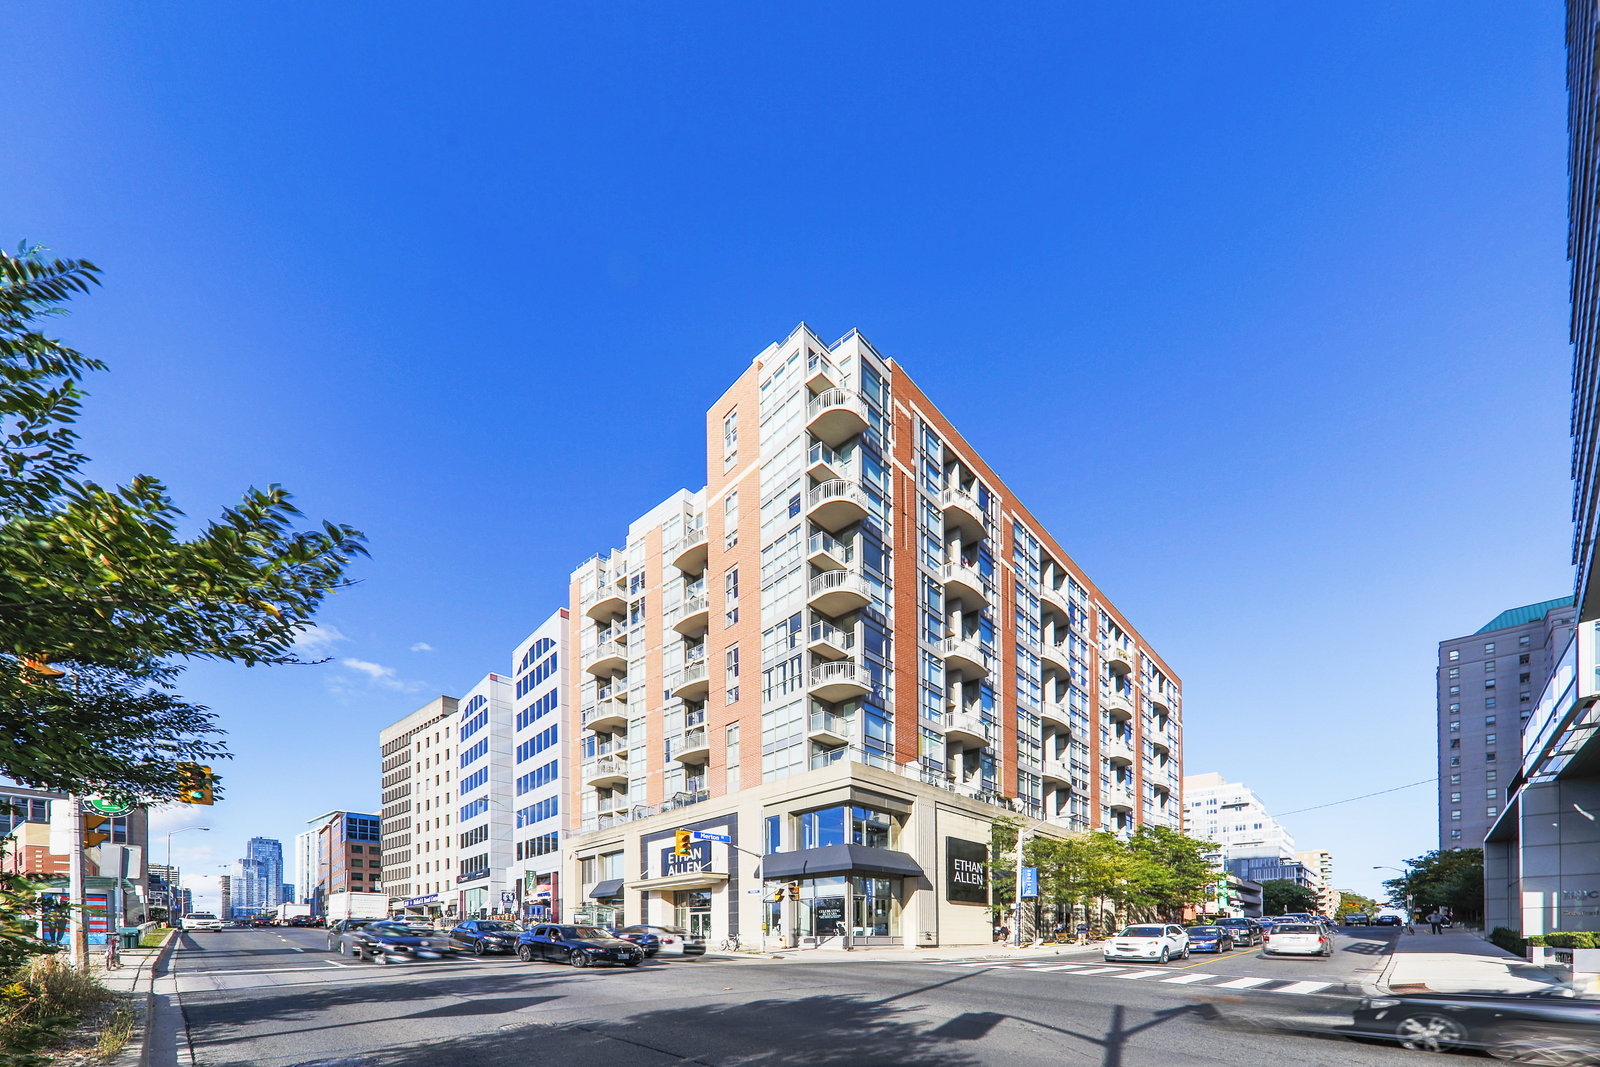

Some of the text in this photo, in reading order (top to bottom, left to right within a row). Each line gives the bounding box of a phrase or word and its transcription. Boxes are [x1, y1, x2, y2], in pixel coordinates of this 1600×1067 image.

[700, 832, 720, 840] Merton
[668, 847, 702, 864] ETHAN
[667, 860, 702, 877] ALLEN
[954, 859, 983, 874] ETHAN
[954, 872, 983, 886] ALLEN
